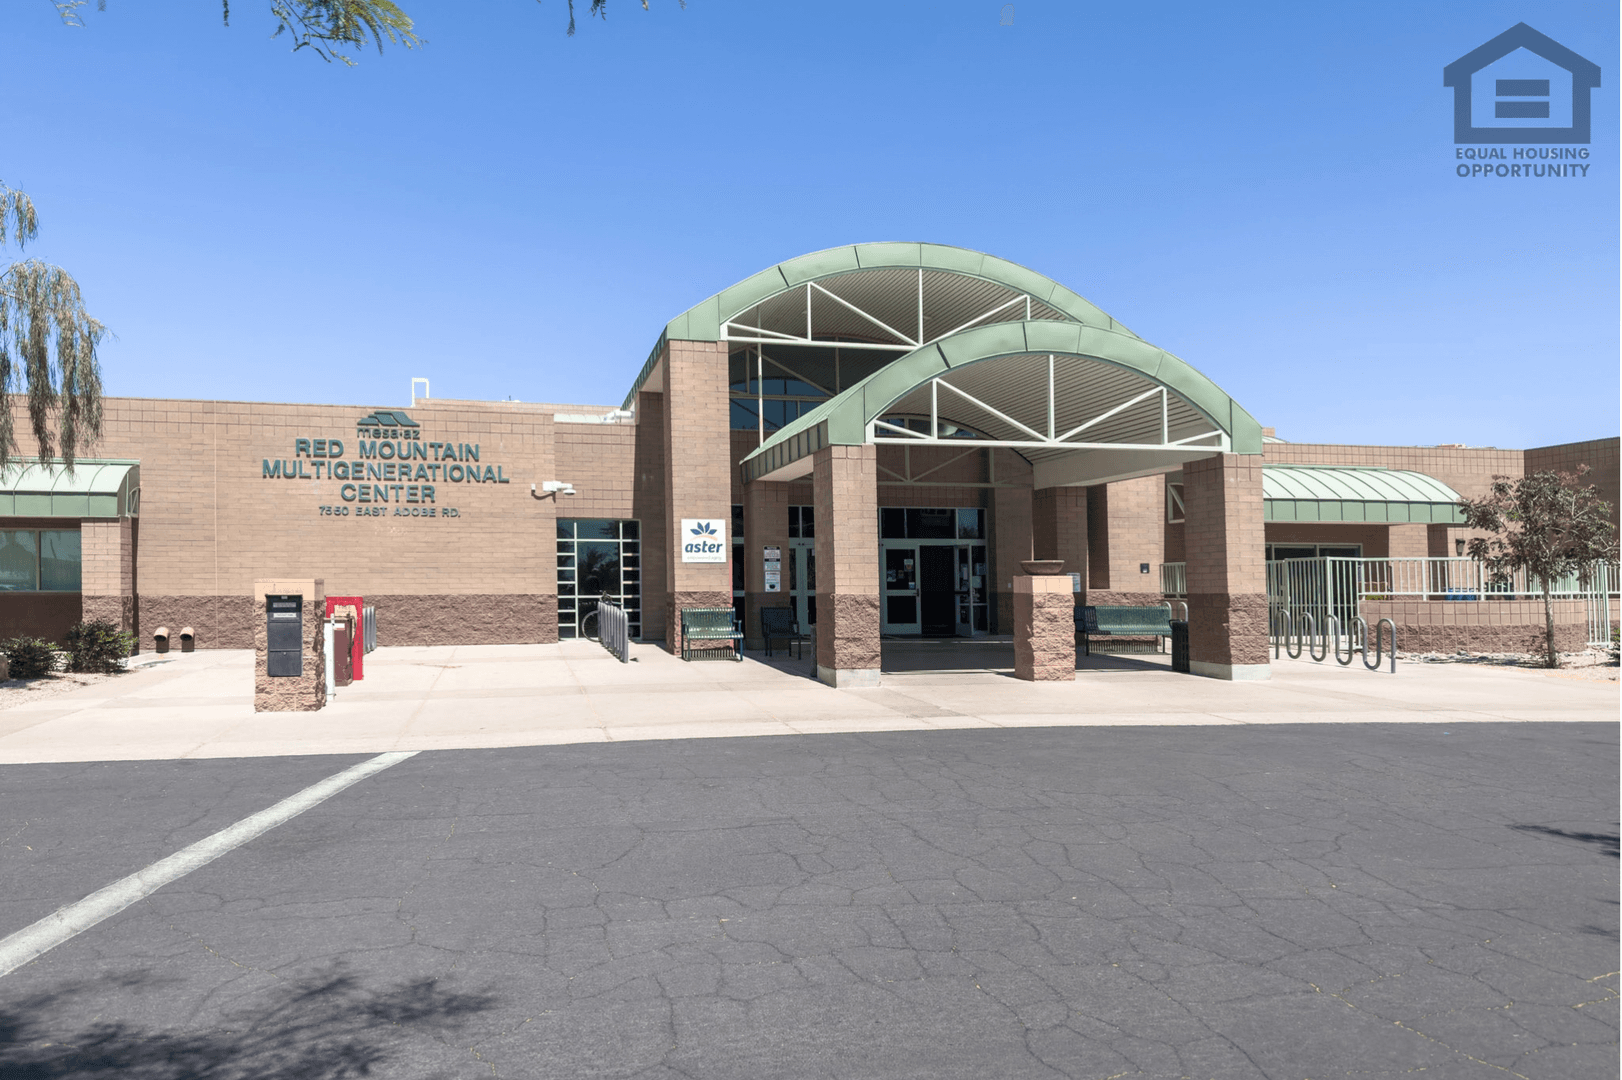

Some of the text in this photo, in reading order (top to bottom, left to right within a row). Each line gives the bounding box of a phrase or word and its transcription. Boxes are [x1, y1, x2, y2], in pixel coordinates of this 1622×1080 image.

[295, 438, 480, 462] RED MOUNTAIN
[262, 459, 510, 484] MULTIGENERATIONAL
[340, 483, 436, 503] CENTER
[355, 506, 387, 516] EAST
[393, 507, 437, 517] ADOBE
[685, 540, 723, 553] aster
